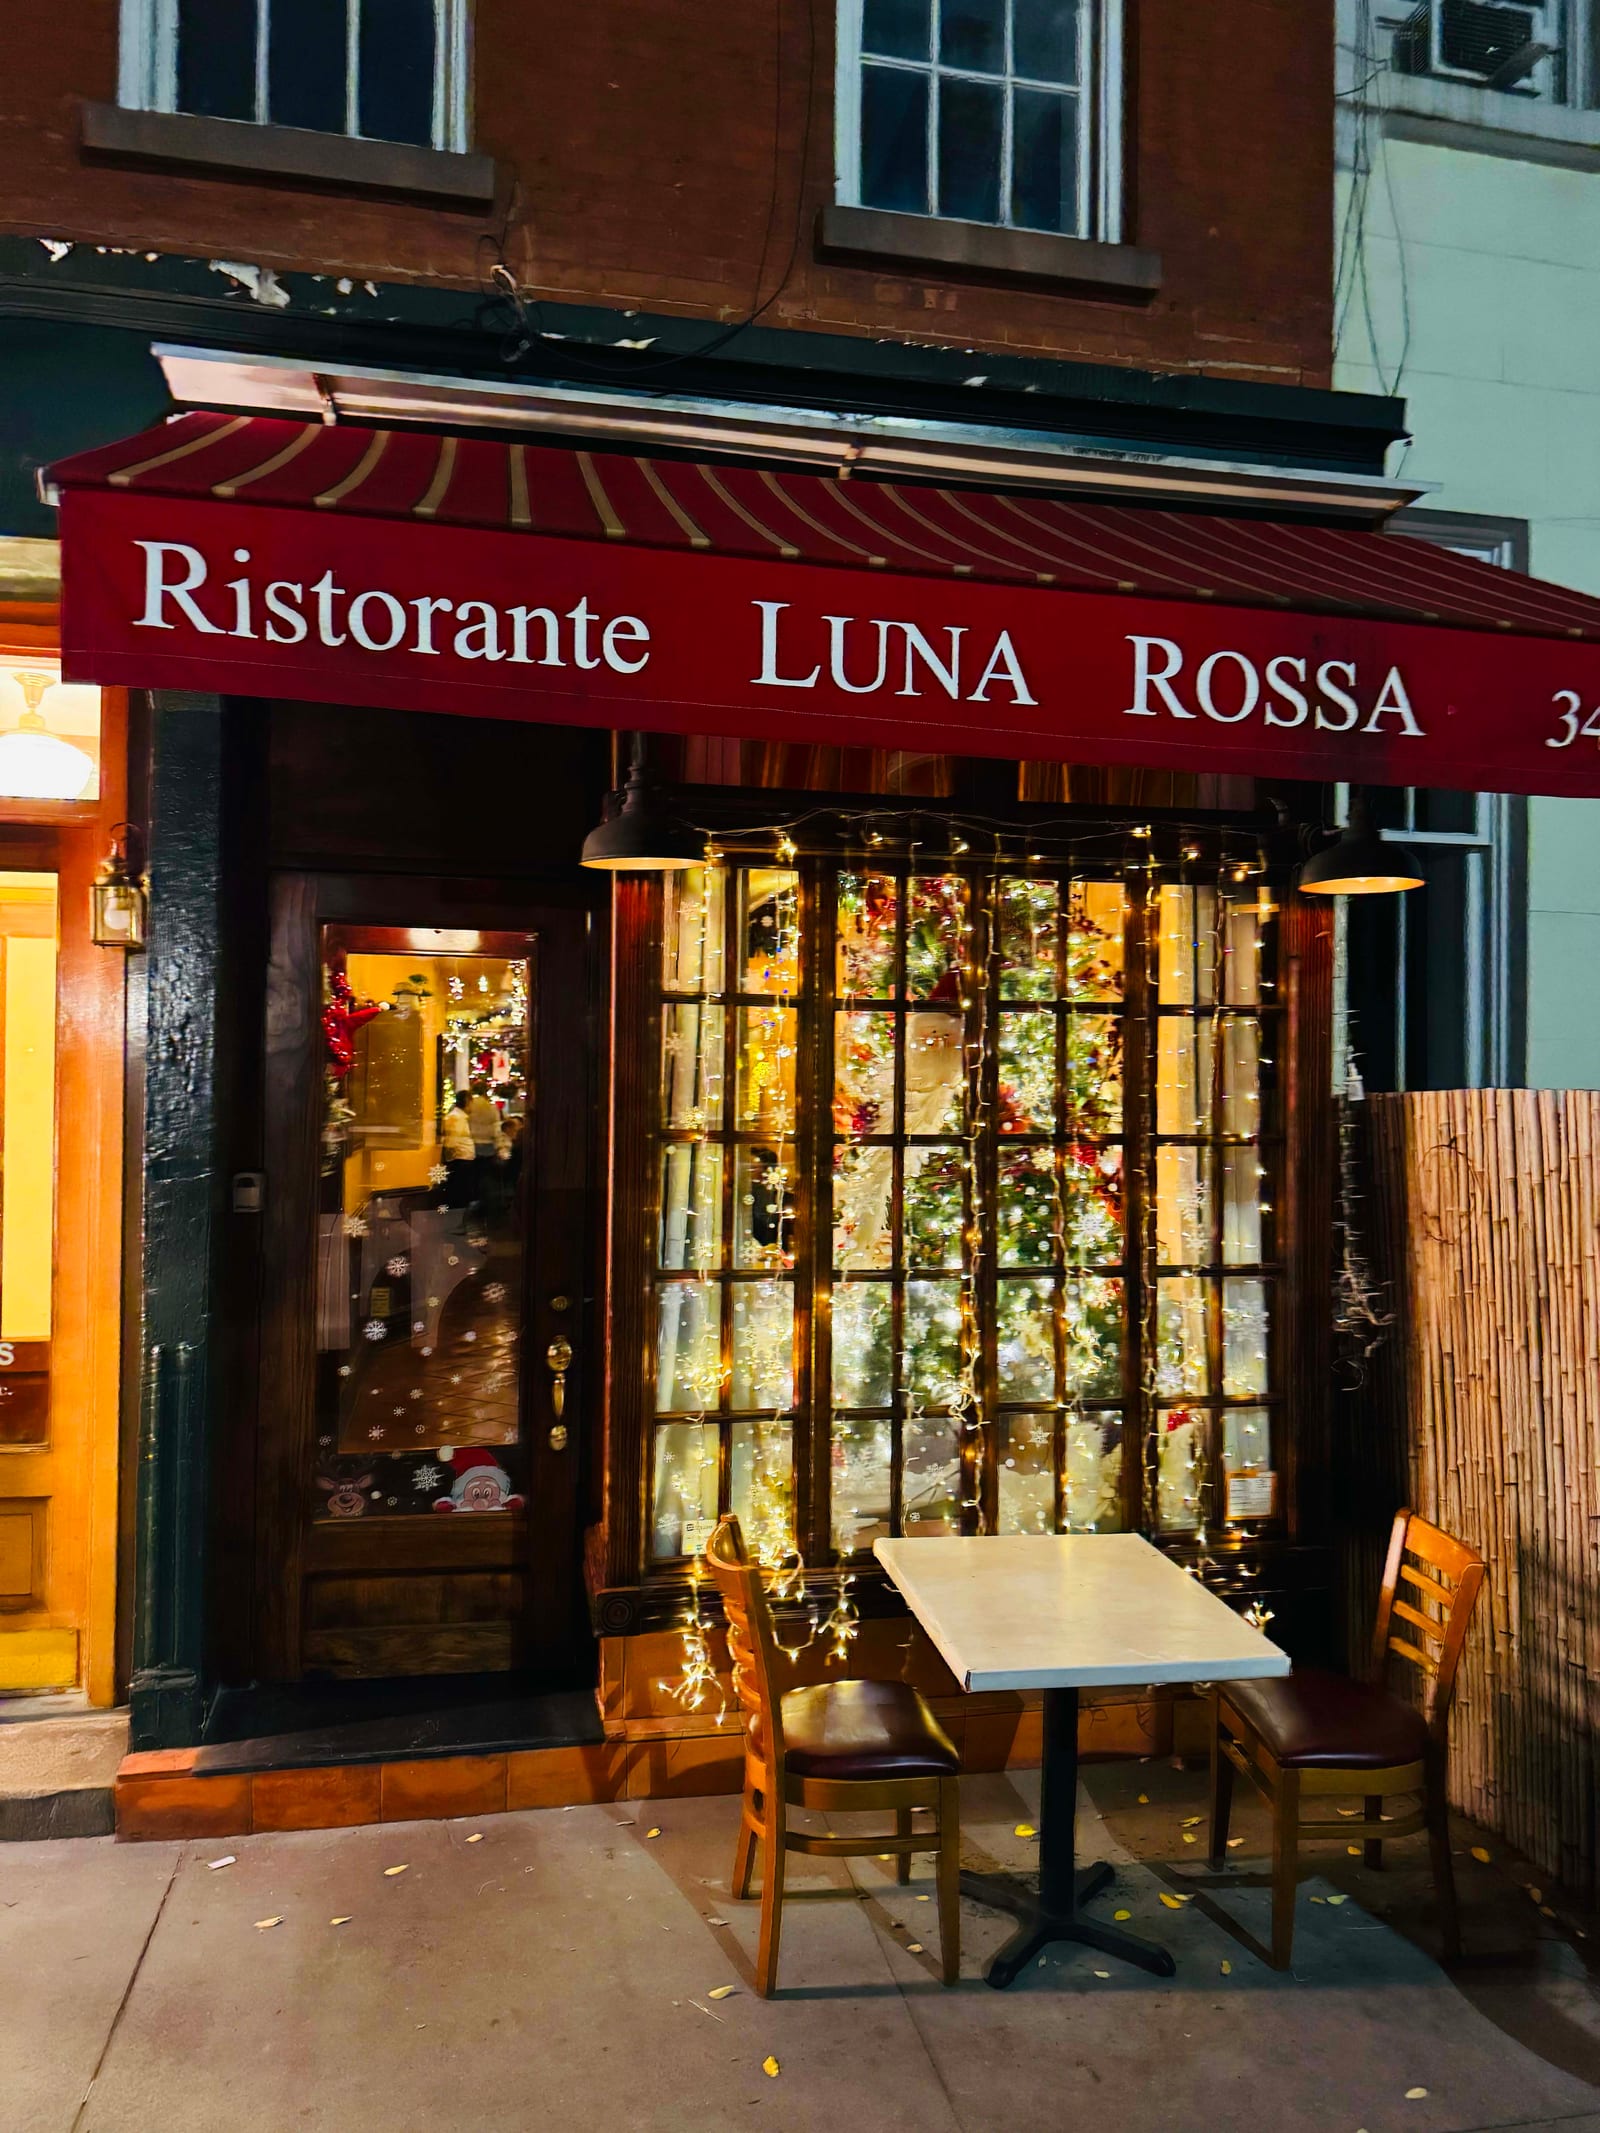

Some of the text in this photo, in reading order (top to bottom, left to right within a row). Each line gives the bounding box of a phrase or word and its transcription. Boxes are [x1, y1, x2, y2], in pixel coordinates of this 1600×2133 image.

[132, 540, 651, 674] Ristorante
[750, 600, 1039, 706] LUNA
[1123, 634, 1426, 737] ROSSA
